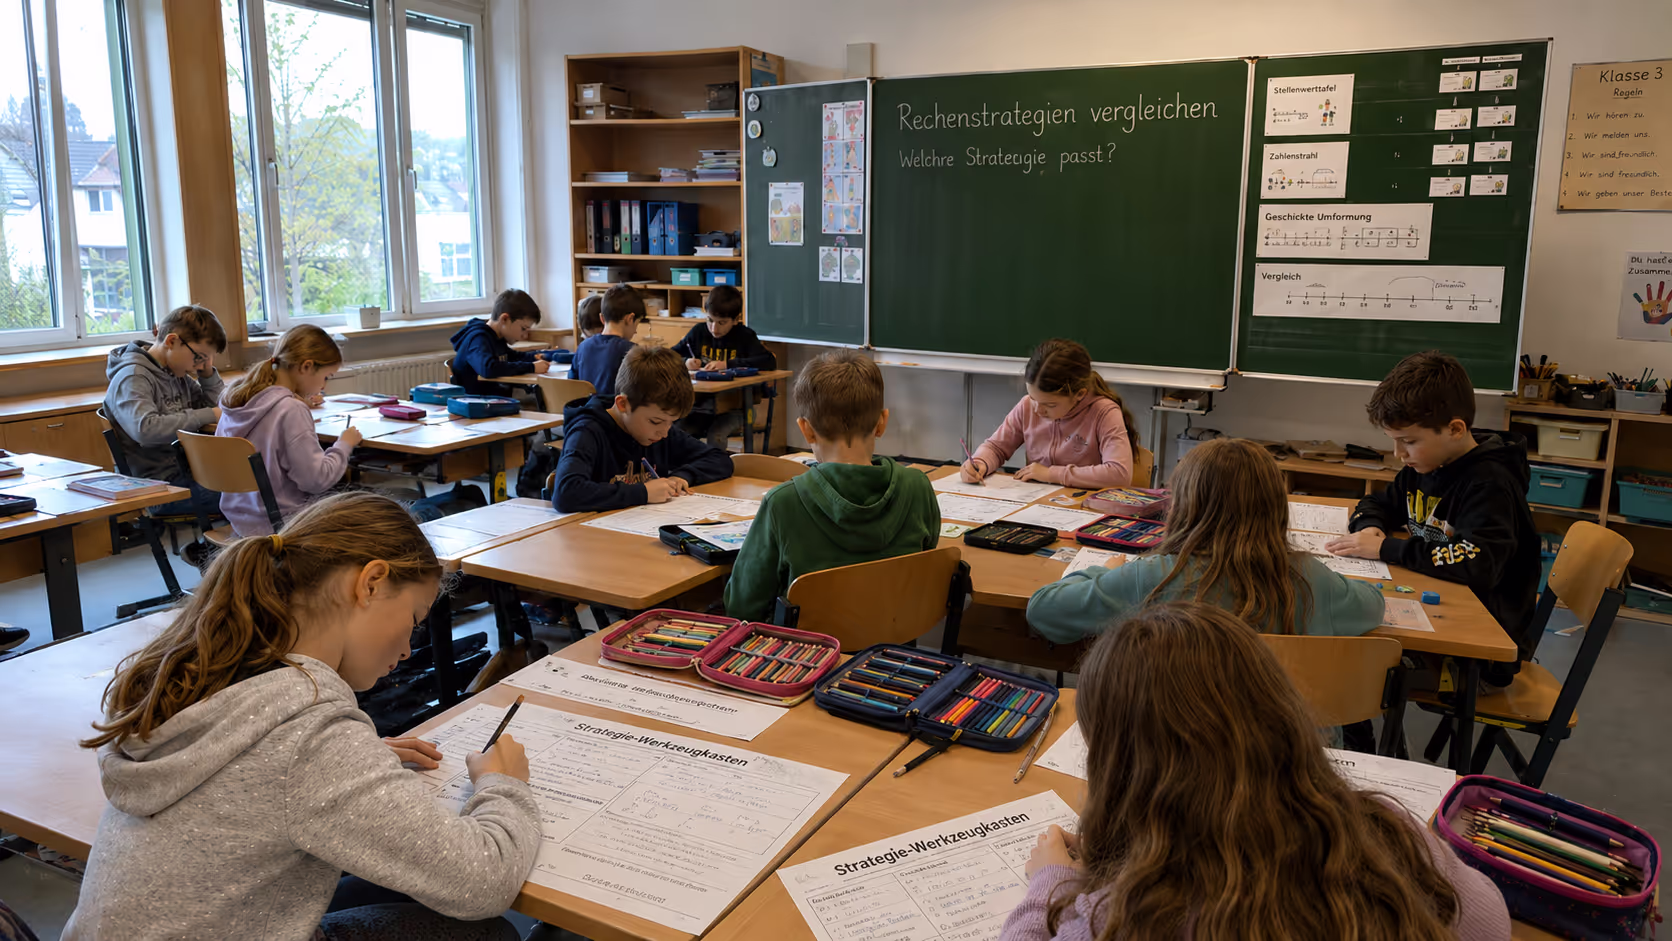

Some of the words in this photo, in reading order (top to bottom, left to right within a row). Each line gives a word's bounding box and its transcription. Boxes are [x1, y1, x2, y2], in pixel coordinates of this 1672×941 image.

[1599, 69, 1650, 83] Klasse
[1654, 66, 1663, 80] 3
[1273, 84, 1337, 95] Stellenwerttafel
[897, 101, 1077, 137] Rechenstrategien
[1090, 91, 1218, 134] vergleichen
[1586, 112, 1600, 120] Wir
[1606, 111, 1629, 119] hören
[1584, 132, 1598, 140] Wir
[1602, 131, 1630, 139] melden
[899, 148, 954, 168] Welchre
[1269, 151, 1318, 160] Zahlenstrahl
[1582, 151, 1596, 159] Wir
[1595, 190, 1618, 199] geben
[1265, 212, 1315, 221] Geschickte
[1317, 213, 1372, 223] Umformung
[1628, 267, 1672, 275] Zusamme
[1261, 272, 1302, 282] Vergleich
[574, 721, 749, 768] Strategie-Werkzeugkasten
[833, 810, 1030, 877] Strategie-Werkzeugkasten
